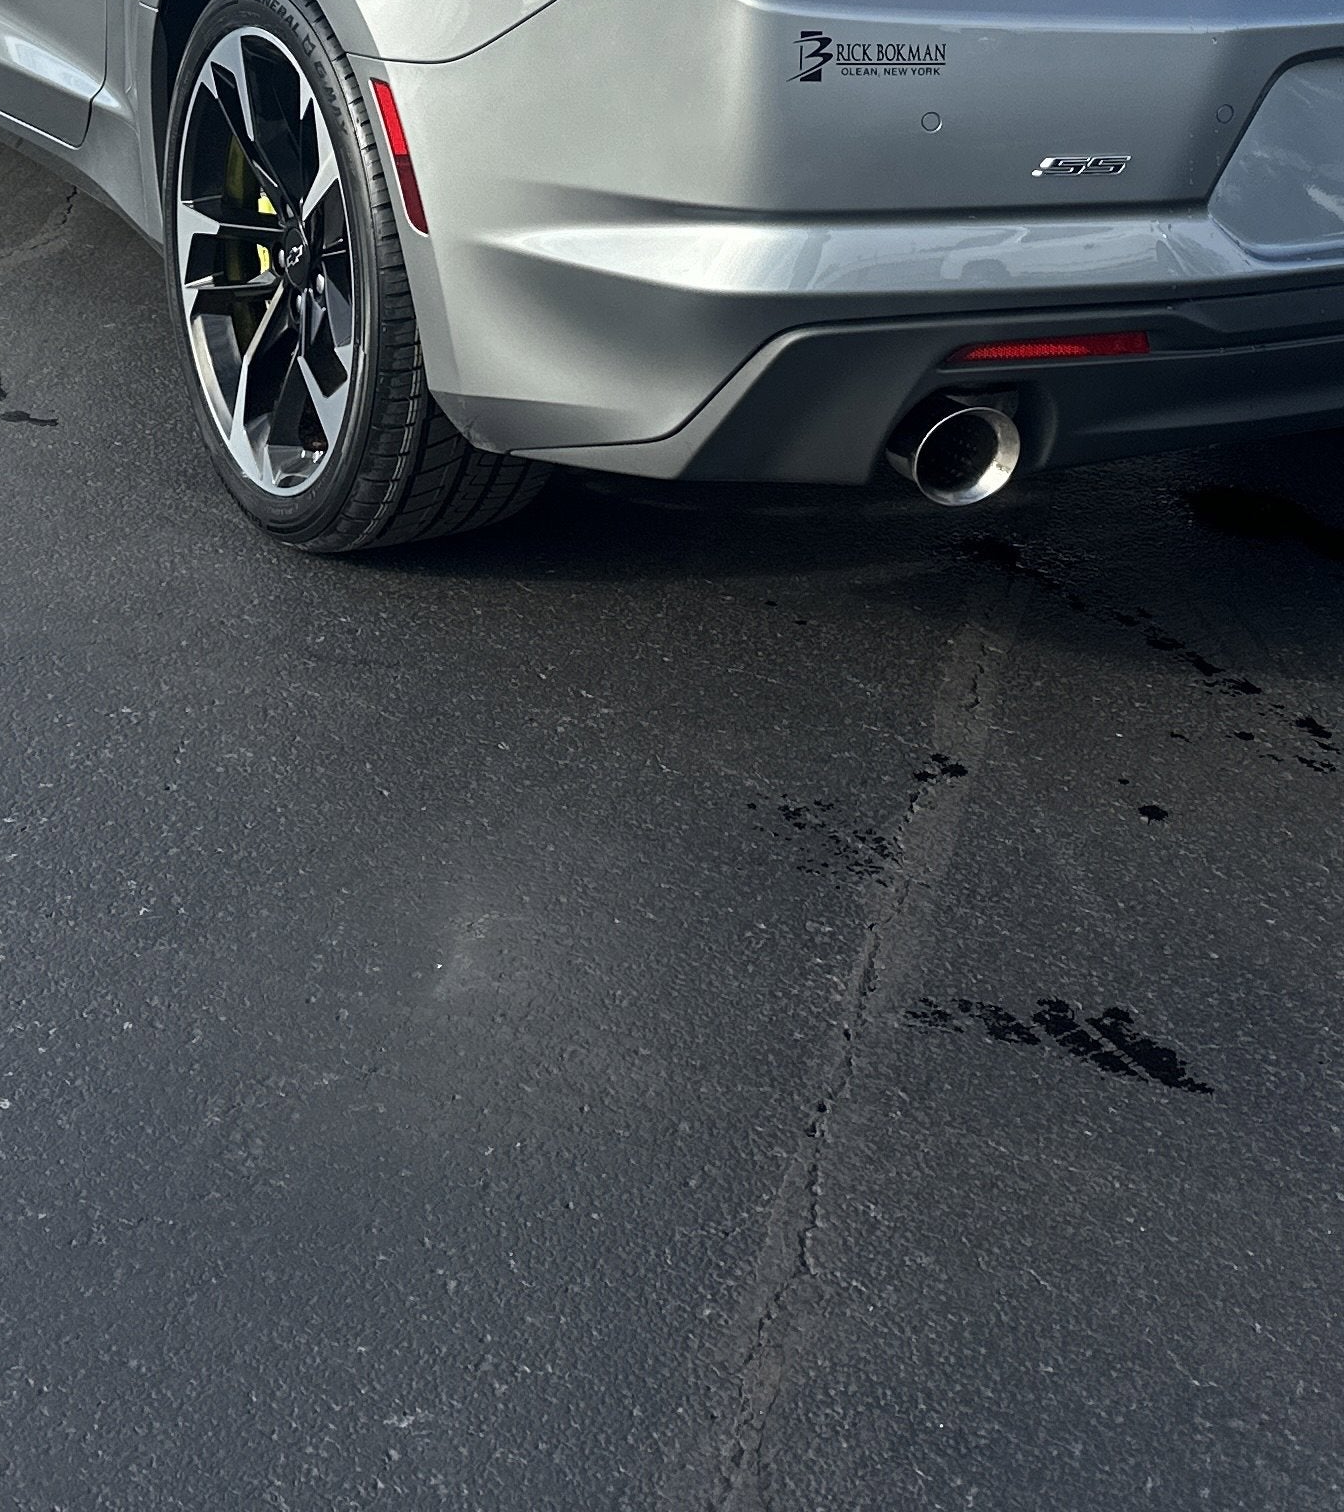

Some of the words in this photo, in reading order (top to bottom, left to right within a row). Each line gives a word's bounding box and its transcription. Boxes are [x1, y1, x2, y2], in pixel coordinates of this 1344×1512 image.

[836, 43, 873, 62] RICK
[876, 43, 947, 62] BOKMAN
[840, 67, 881, 78] OLEAN,
[883, 67, 907, 76] NEW
[911, 67, 941, 76] YORK
